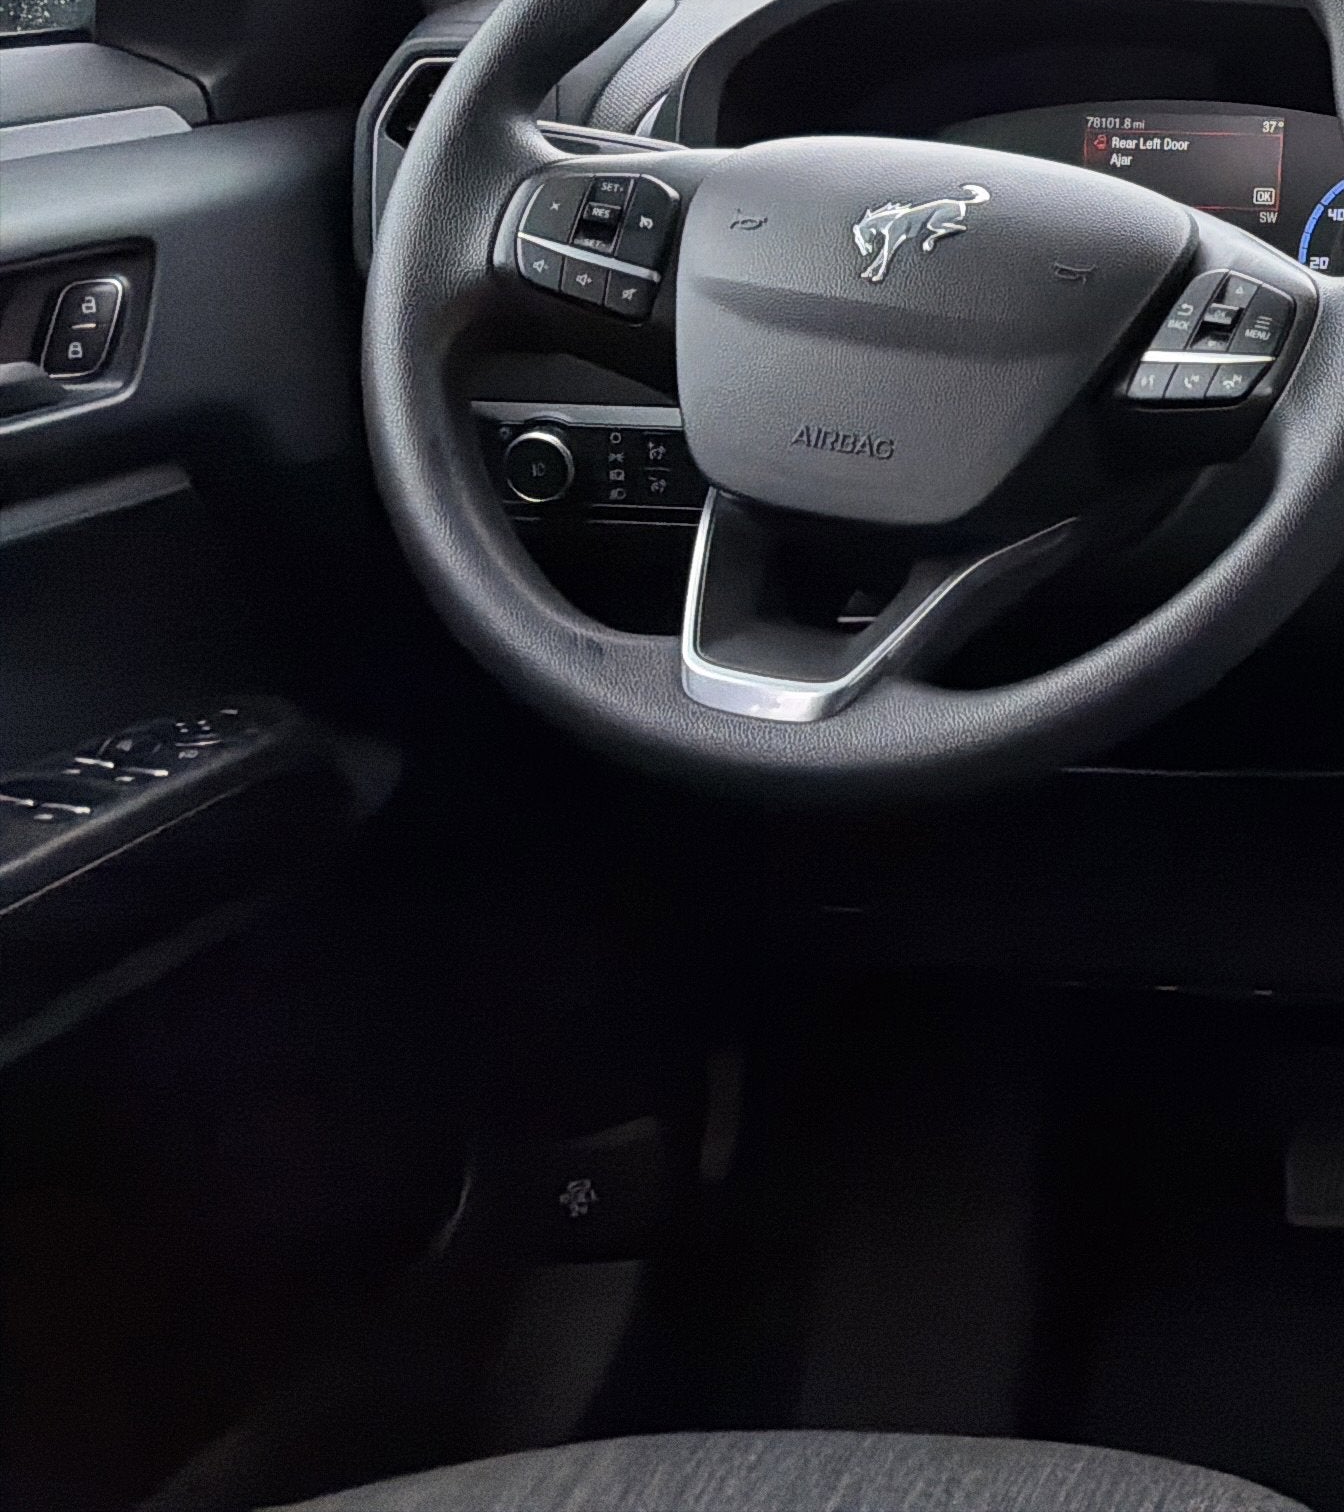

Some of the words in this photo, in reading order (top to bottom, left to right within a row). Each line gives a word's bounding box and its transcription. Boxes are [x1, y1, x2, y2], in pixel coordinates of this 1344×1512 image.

[1087, 116, 1131, 130] 78101.8
[1132, 119, 1145, 130] mi
[1111, 137, 1138, 150] Rear
[1140, 138, 1161, 150] Left
[1163, 138, 1190, 151] Door
[1110, 153, 1133, 168] Ajar
[1256, 190, 1273, 203] OK
[1259, 211, 1278, 224] SW
[1310, 256, 1330, 270] 20
[1245, 328, 1272, 341] MENU
[791, 425, 897, 462] AIRBAG
